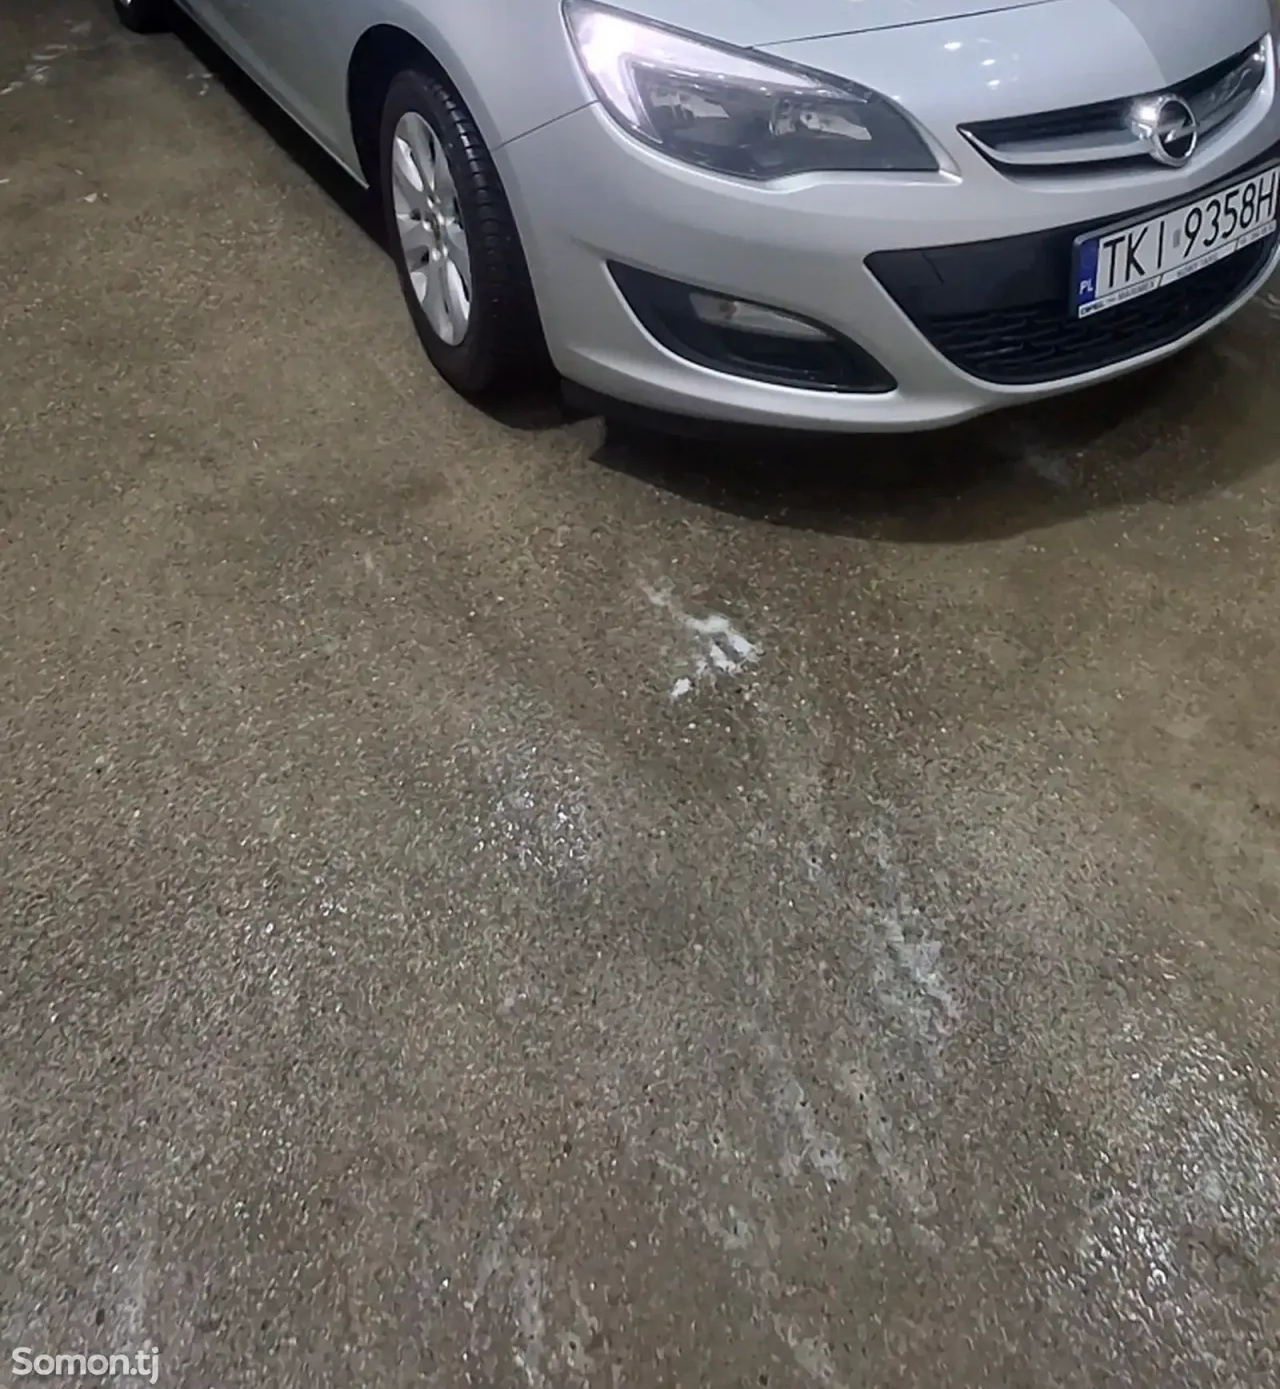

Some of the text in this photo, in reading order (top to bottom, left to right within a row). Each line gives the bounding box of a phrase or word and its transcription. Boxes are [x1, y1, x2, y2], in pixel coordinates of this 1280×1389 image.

[1103, 171, 1276, 289] TKI 9358H
[1079, 278, 1094, 295] PL
